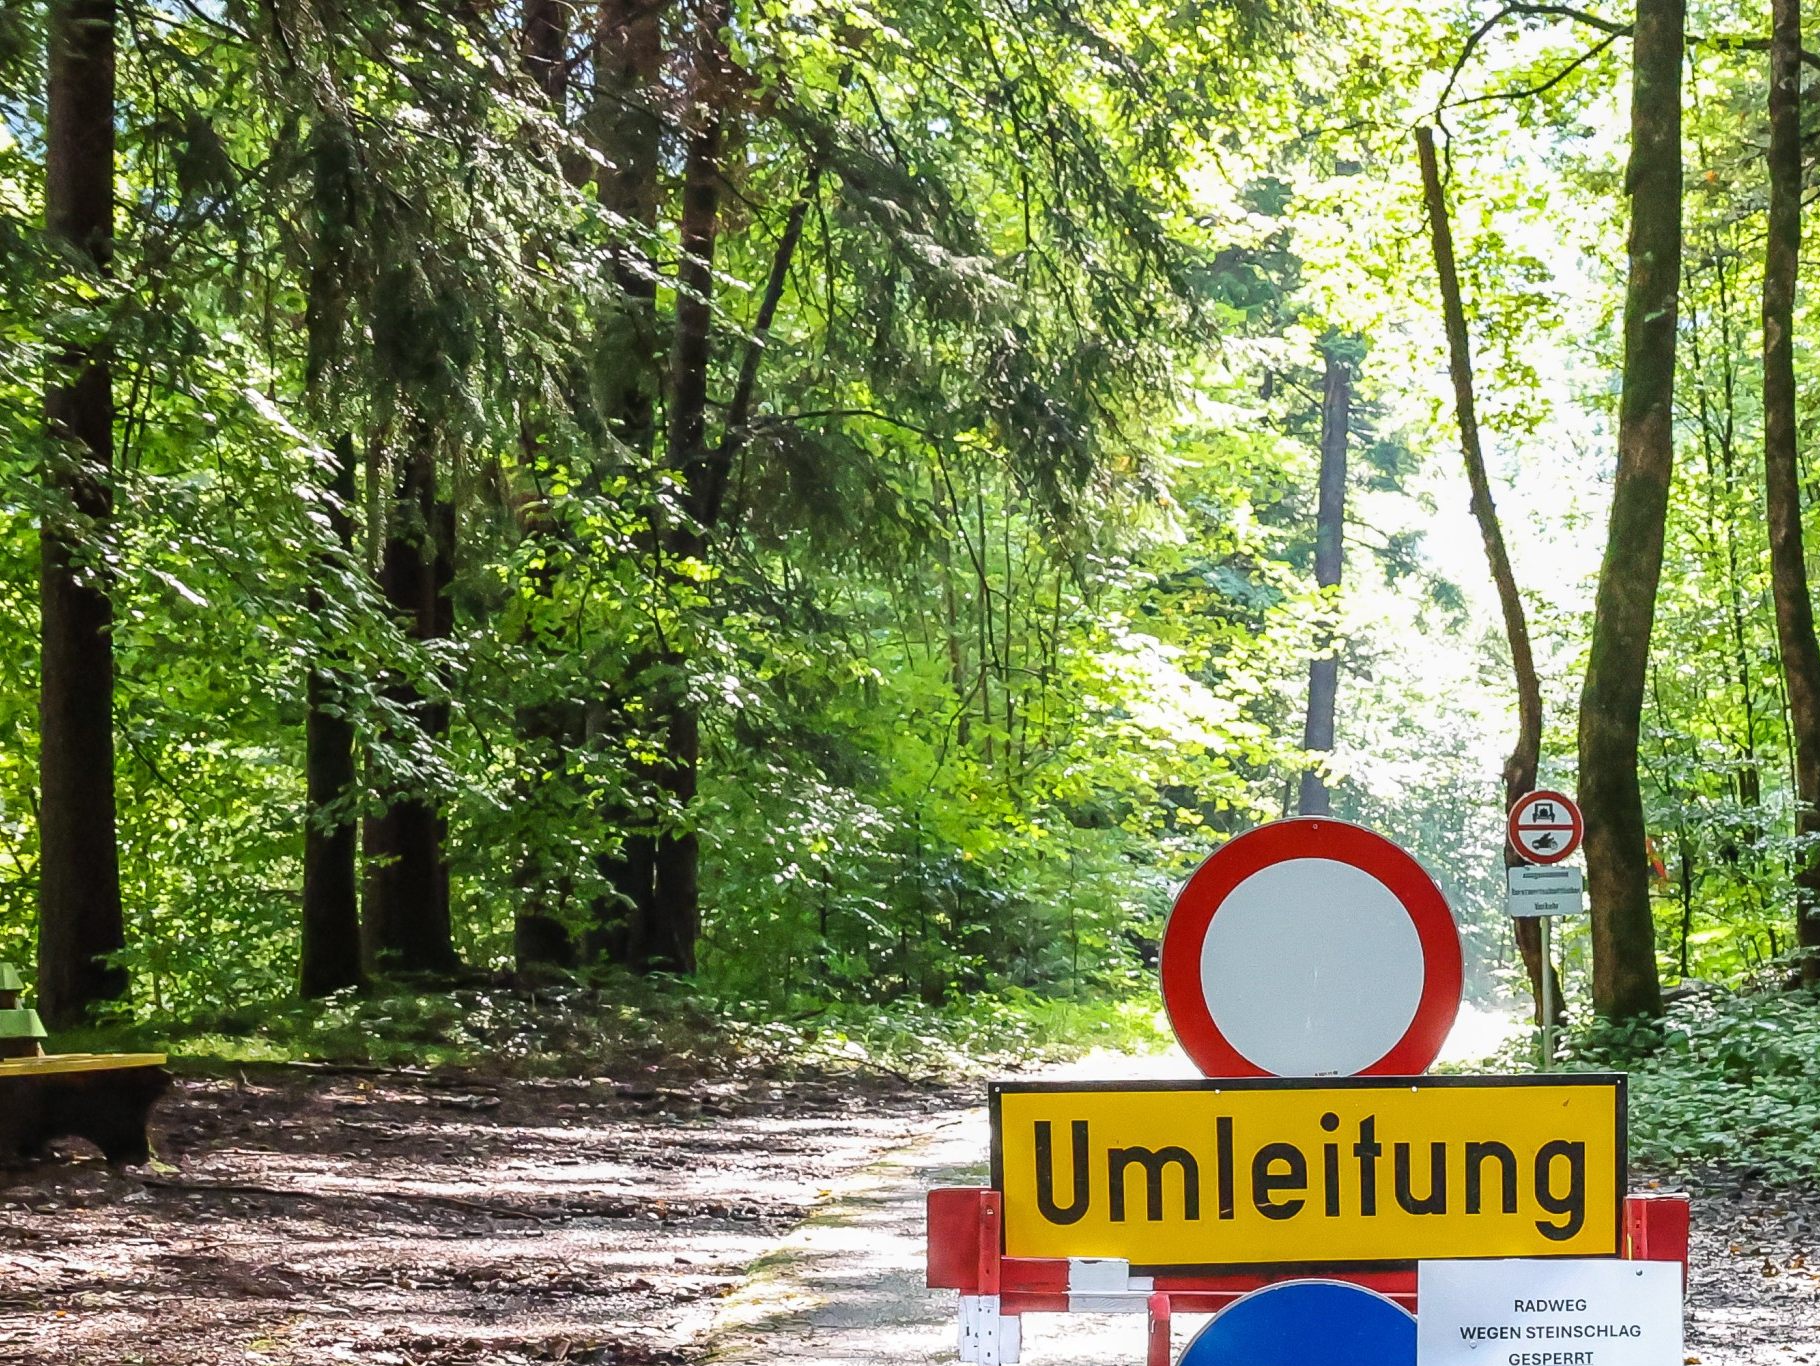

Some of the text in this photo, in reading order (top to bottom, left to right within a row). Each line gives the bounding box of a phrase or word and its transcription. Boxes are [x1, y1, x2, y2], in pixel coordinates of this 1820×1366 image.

[1034, 1112, 1586, 1241] Umleitung
[1514, 1299, 1587, 1312] RADWEG
[1459, 1325, 1641, 1340] WEGEN STEINSCHLAG
[1508, 1352, 1594, 1366] GESPERRT
